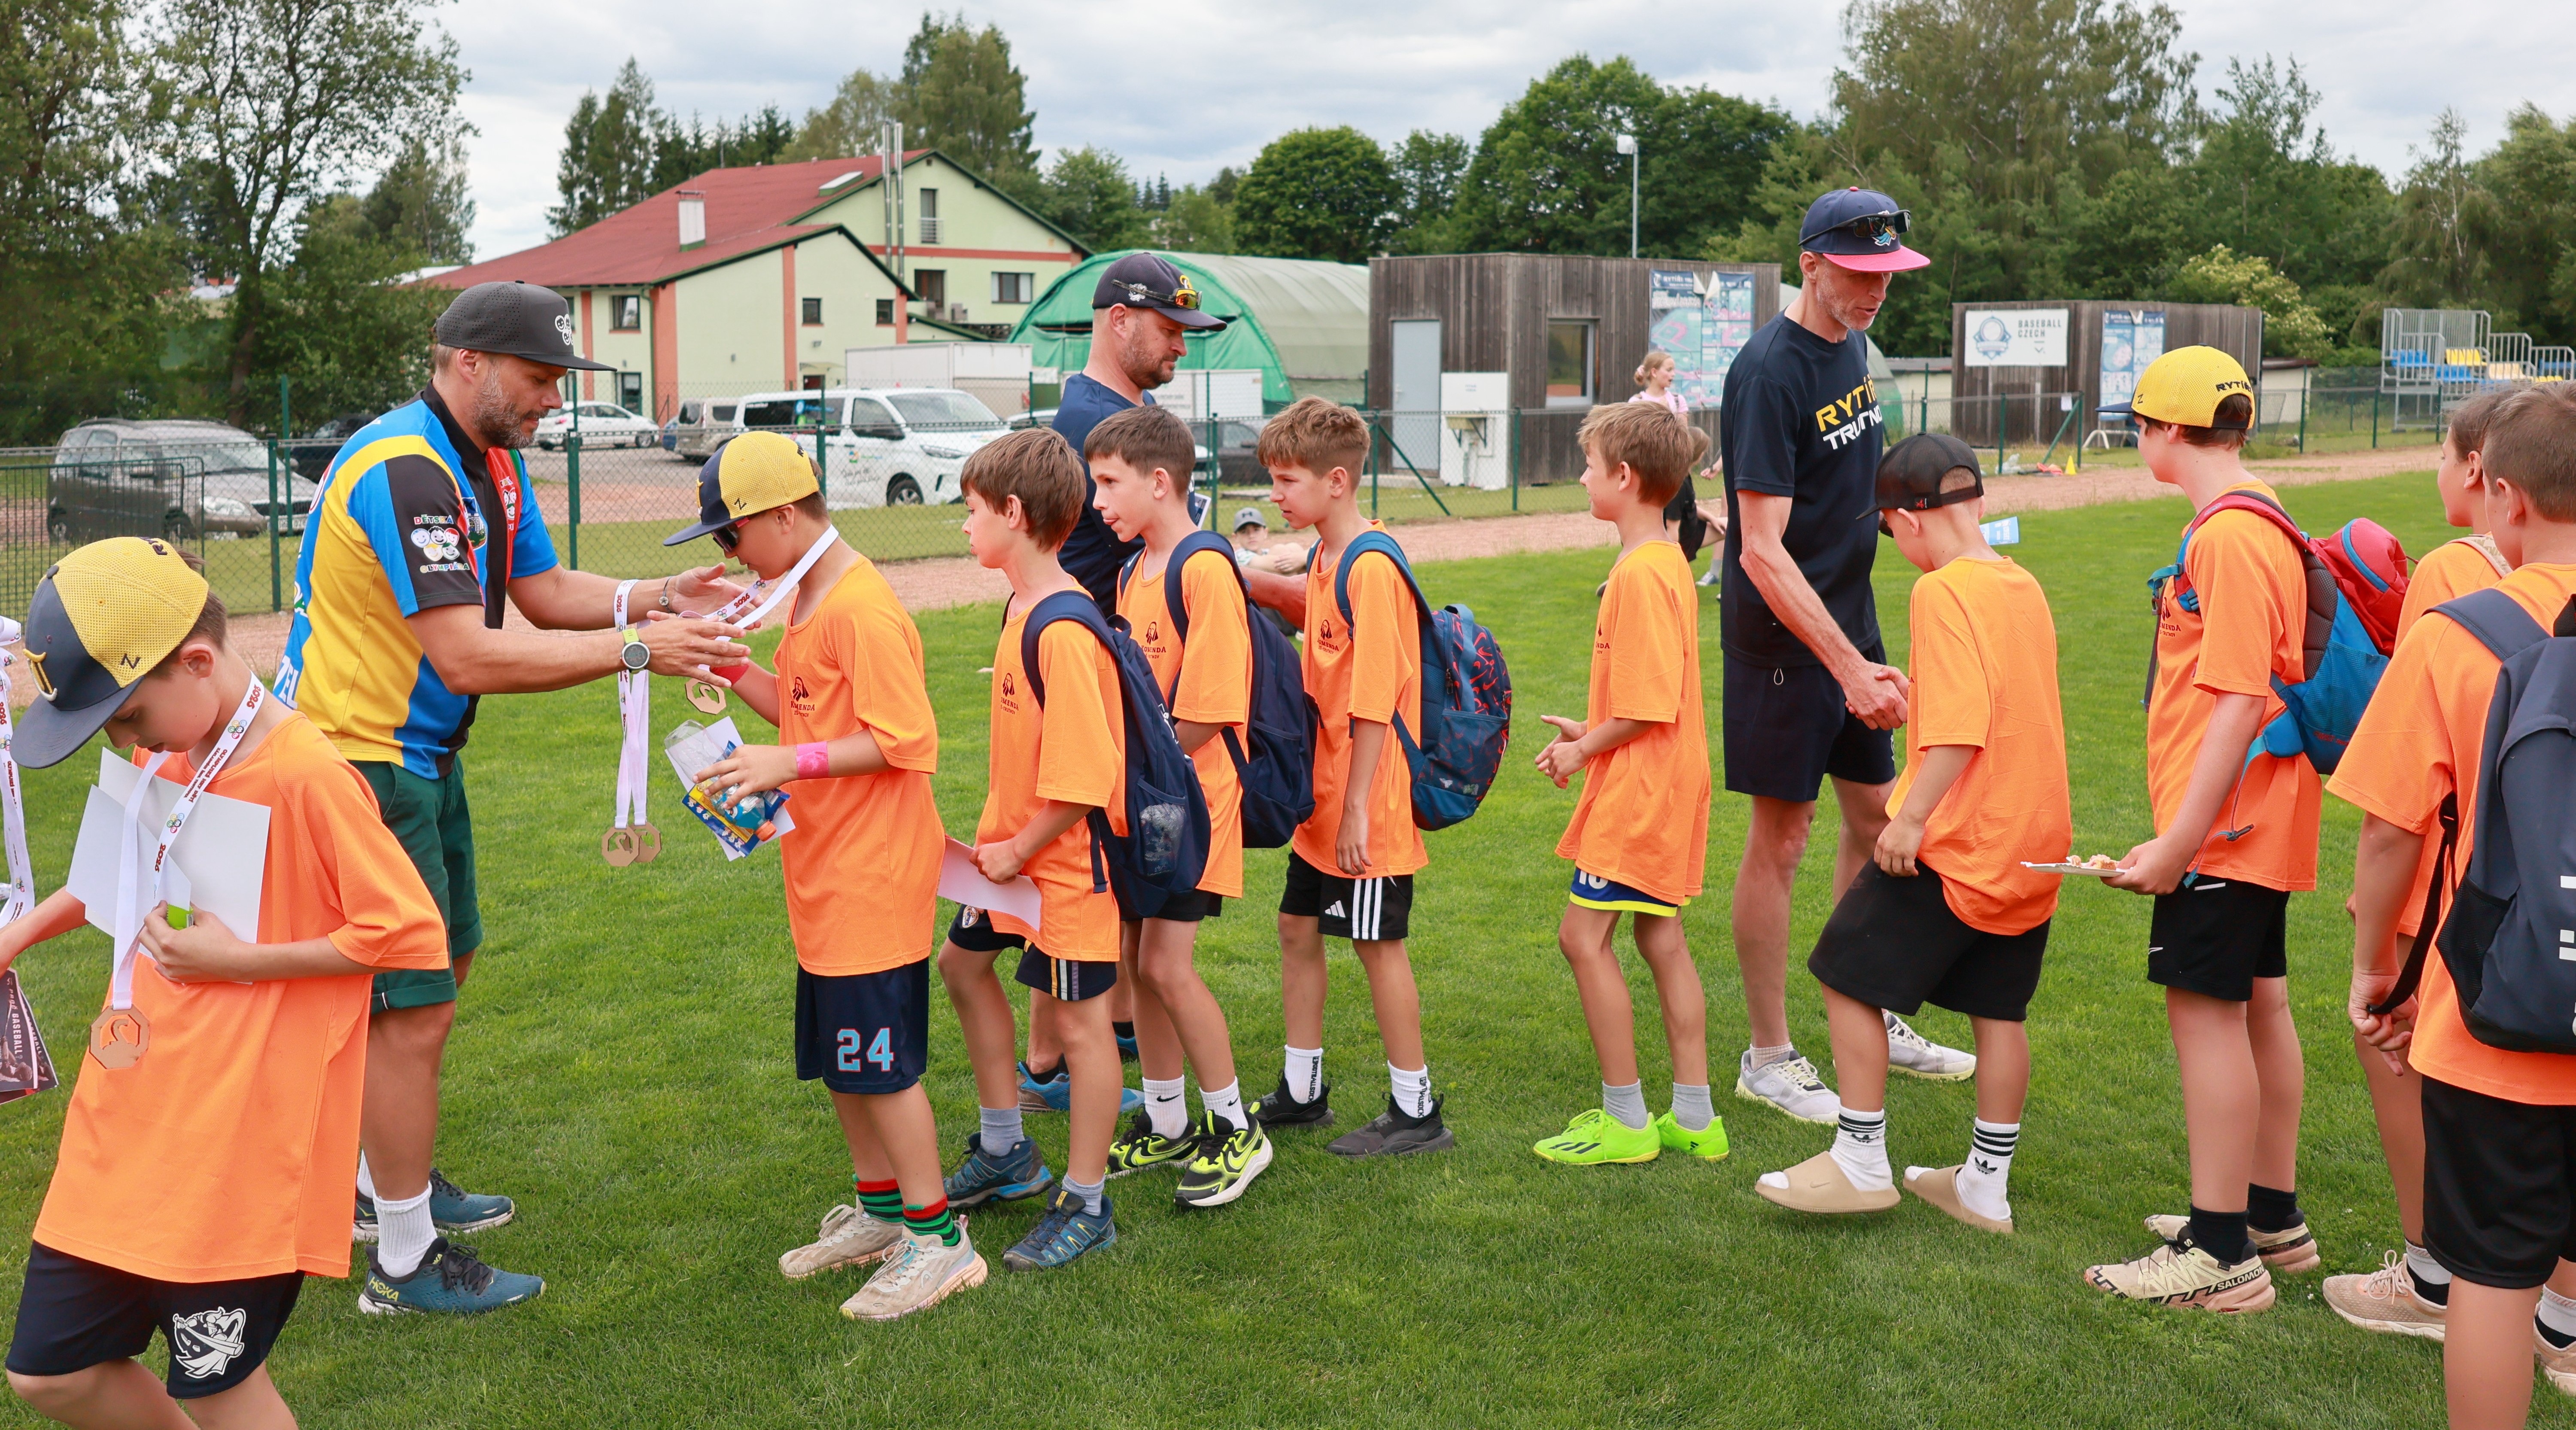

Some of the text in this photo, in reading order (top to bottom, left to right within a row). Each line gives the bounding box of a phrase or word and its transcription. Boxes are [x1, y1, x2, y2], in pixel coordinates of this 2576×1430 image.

[2018, 319, 2061, 328] BASEBALL
[2018, 329, 2045, 338] CZECH
[413, 514, 454, 525] DĚTSKÁ
[419, 562, 470, 573] OLYMPIÁDA
[734, 593, 750, 609] 2026
[246, 684, 261, 709] 2026
[155, 843, 166, 873] 2026
[836, 1026, 895, 1072] 24
[2217, 1264, 2265, 1290] SALOMON
[368, 1275, 400, 1302] HOKA
